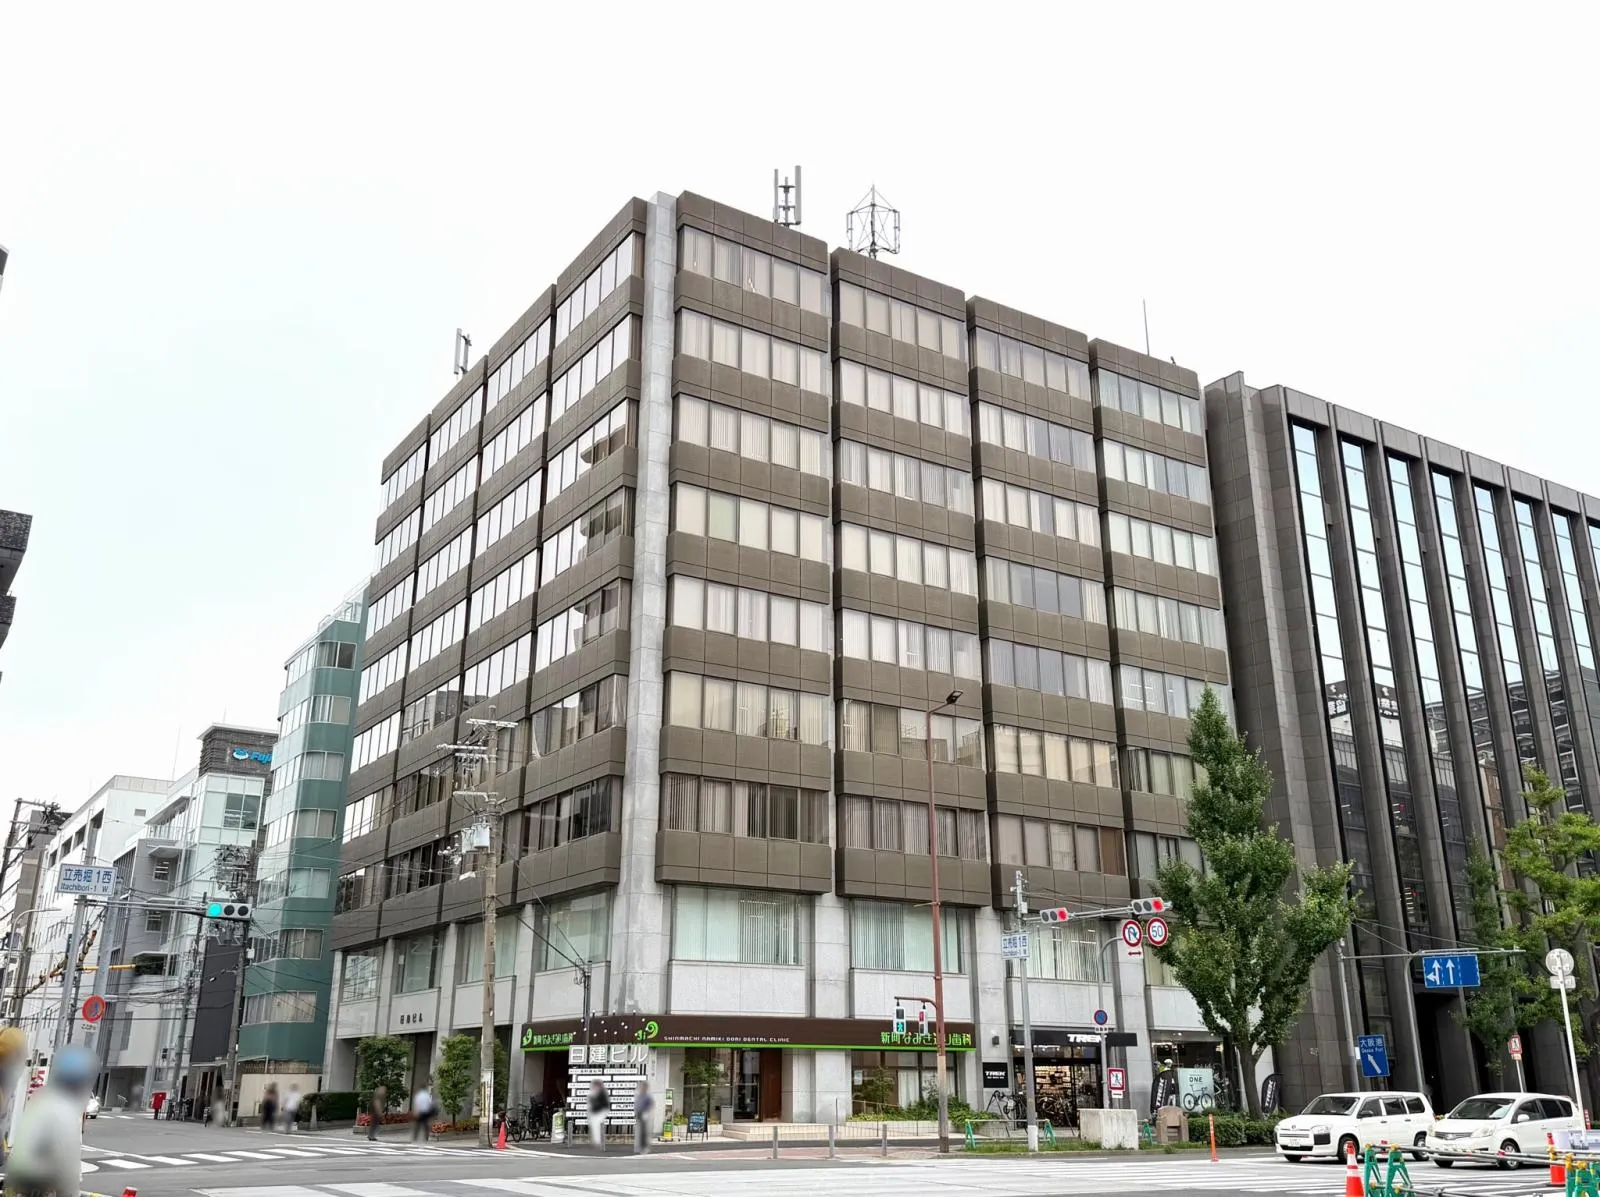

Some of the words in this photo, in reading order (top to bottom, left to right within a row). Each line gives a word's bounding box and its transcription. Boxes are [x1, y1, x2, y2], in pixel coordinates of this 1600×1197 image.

[1151, 925, 1164, 938] 50
[570, 1045, 649, 1064] 日建ビル
[1189, 1075, 1203, 1083] ONE
